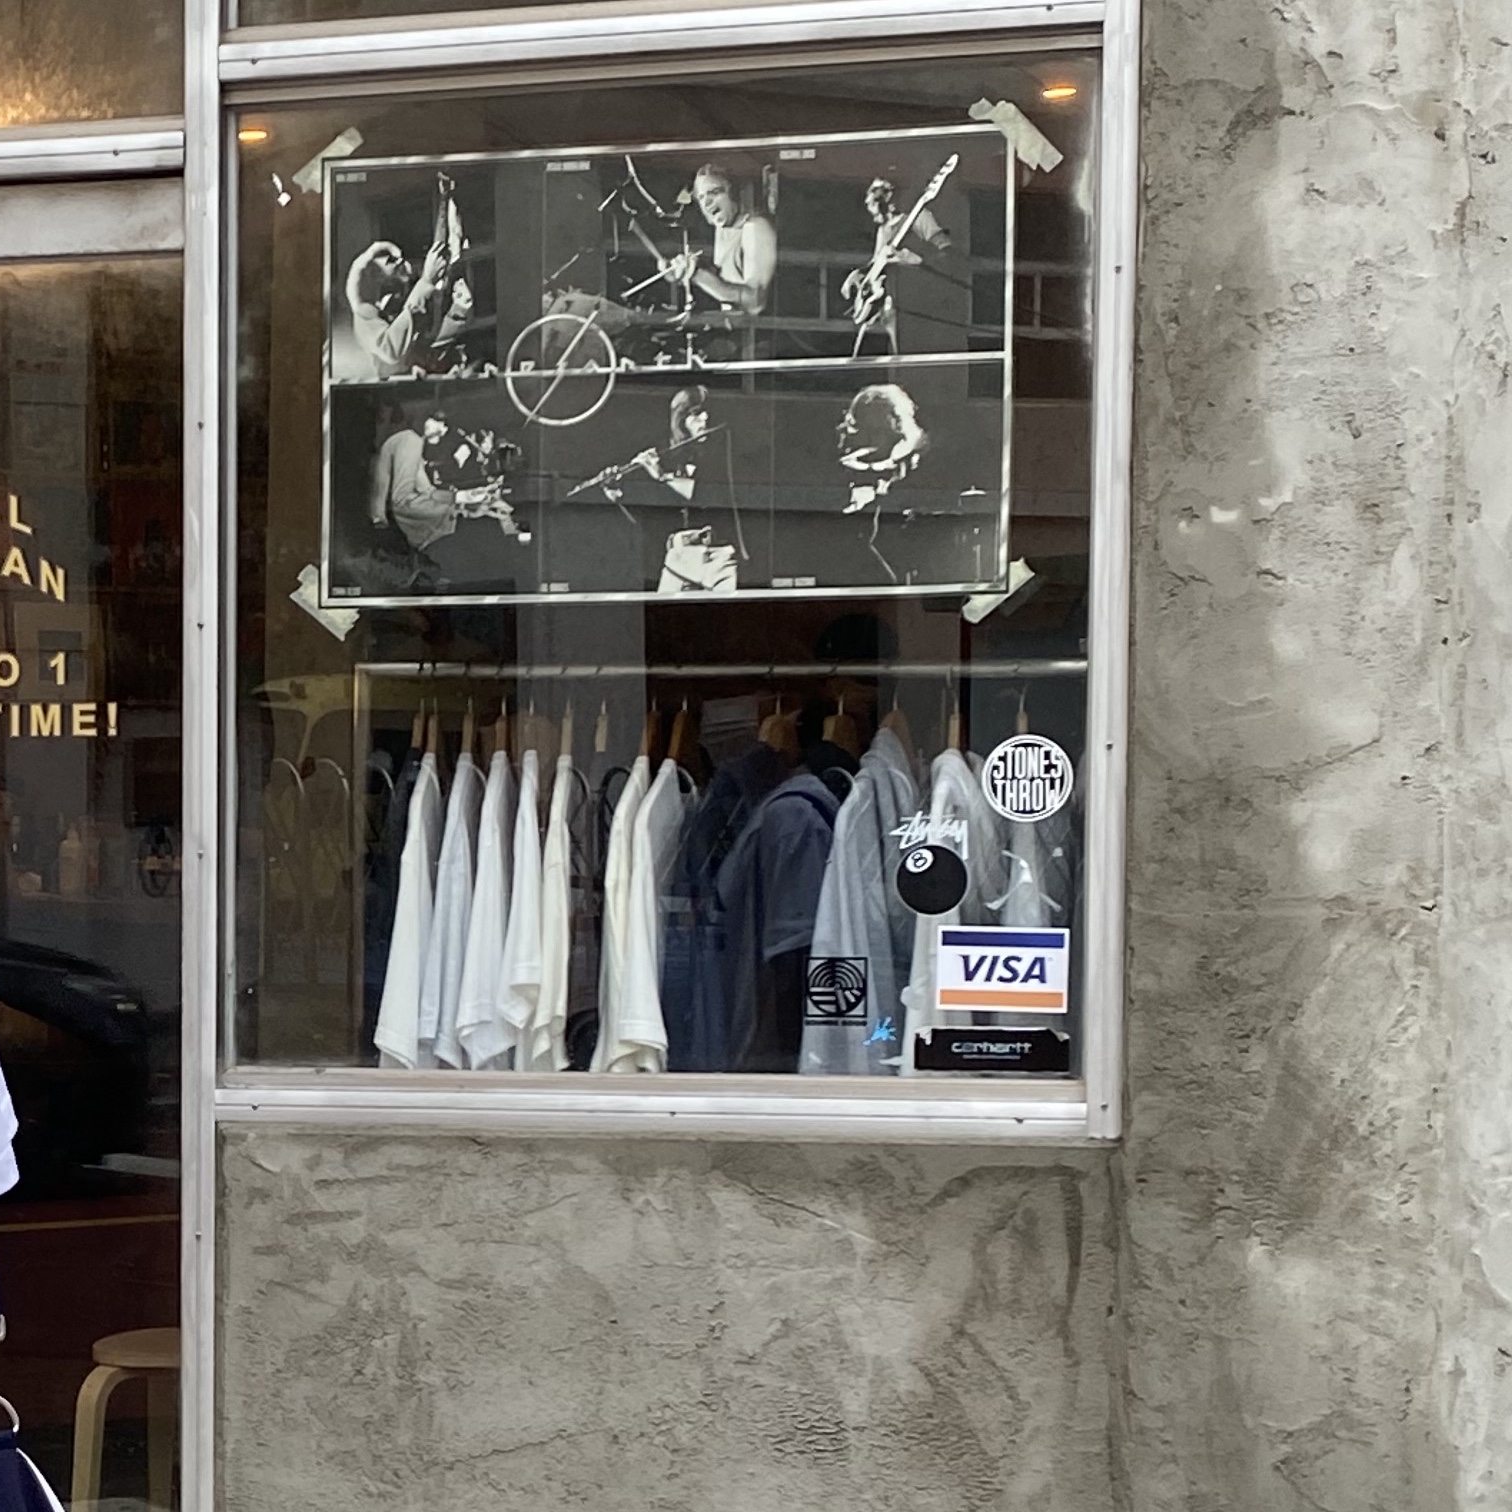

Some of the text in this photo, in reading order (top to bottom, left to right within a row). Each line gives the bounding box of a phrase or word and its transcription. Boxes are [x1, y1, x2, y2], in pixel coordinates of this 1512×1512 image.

[49, 651, 66, 686] 1
[993, 746, 1062, 780] STONES
[993, 778, 1060, 811] THROW
[912, 852, 927, 868] 8
[959, 954, 1047, 984] VISA
